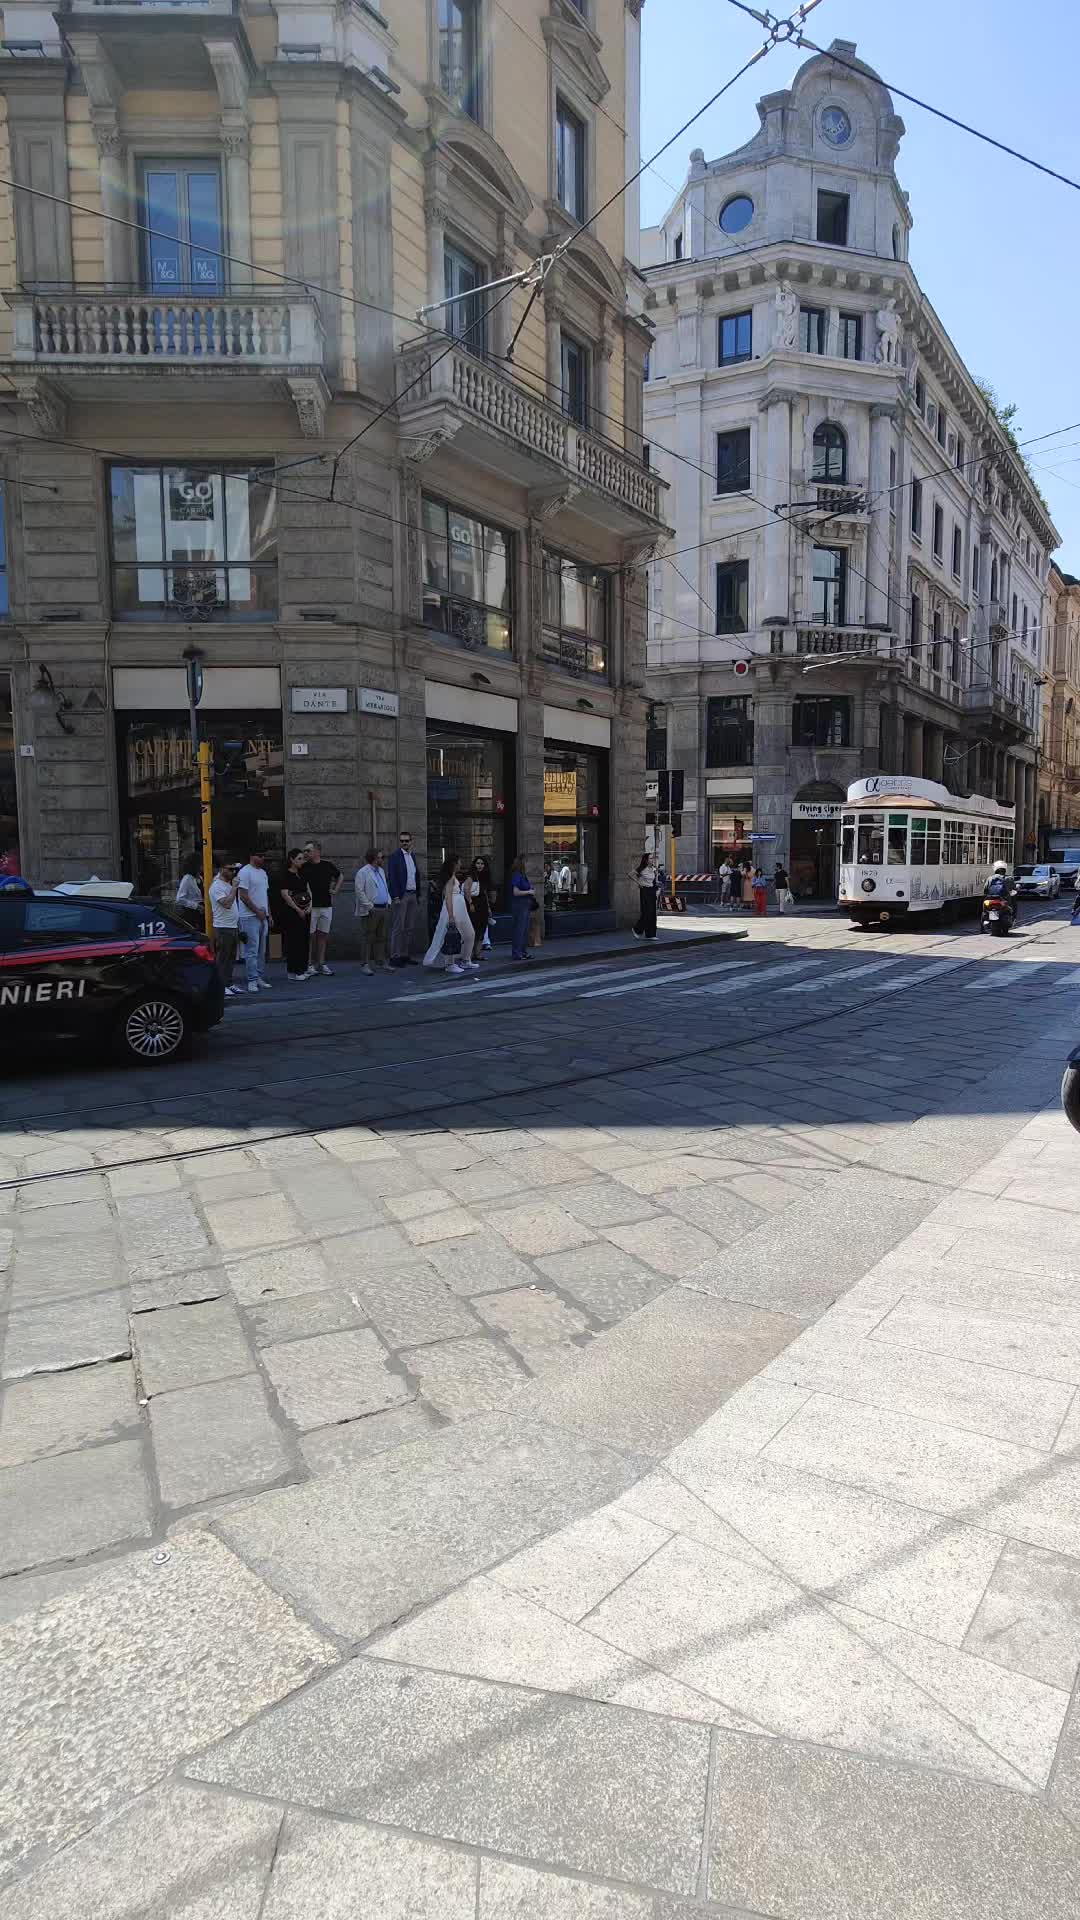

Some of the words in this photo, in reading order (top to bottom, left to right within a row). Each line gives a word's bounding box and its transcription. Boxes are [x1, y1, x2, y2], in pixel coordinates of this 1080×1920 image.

[180, 482, 212, 500] GO
[451, 526, 471, 545] GO
[799, 804, 822, 815] flying
[138, 921, 166, 936] 112
[0, 979, 86, 1005] NIERI
